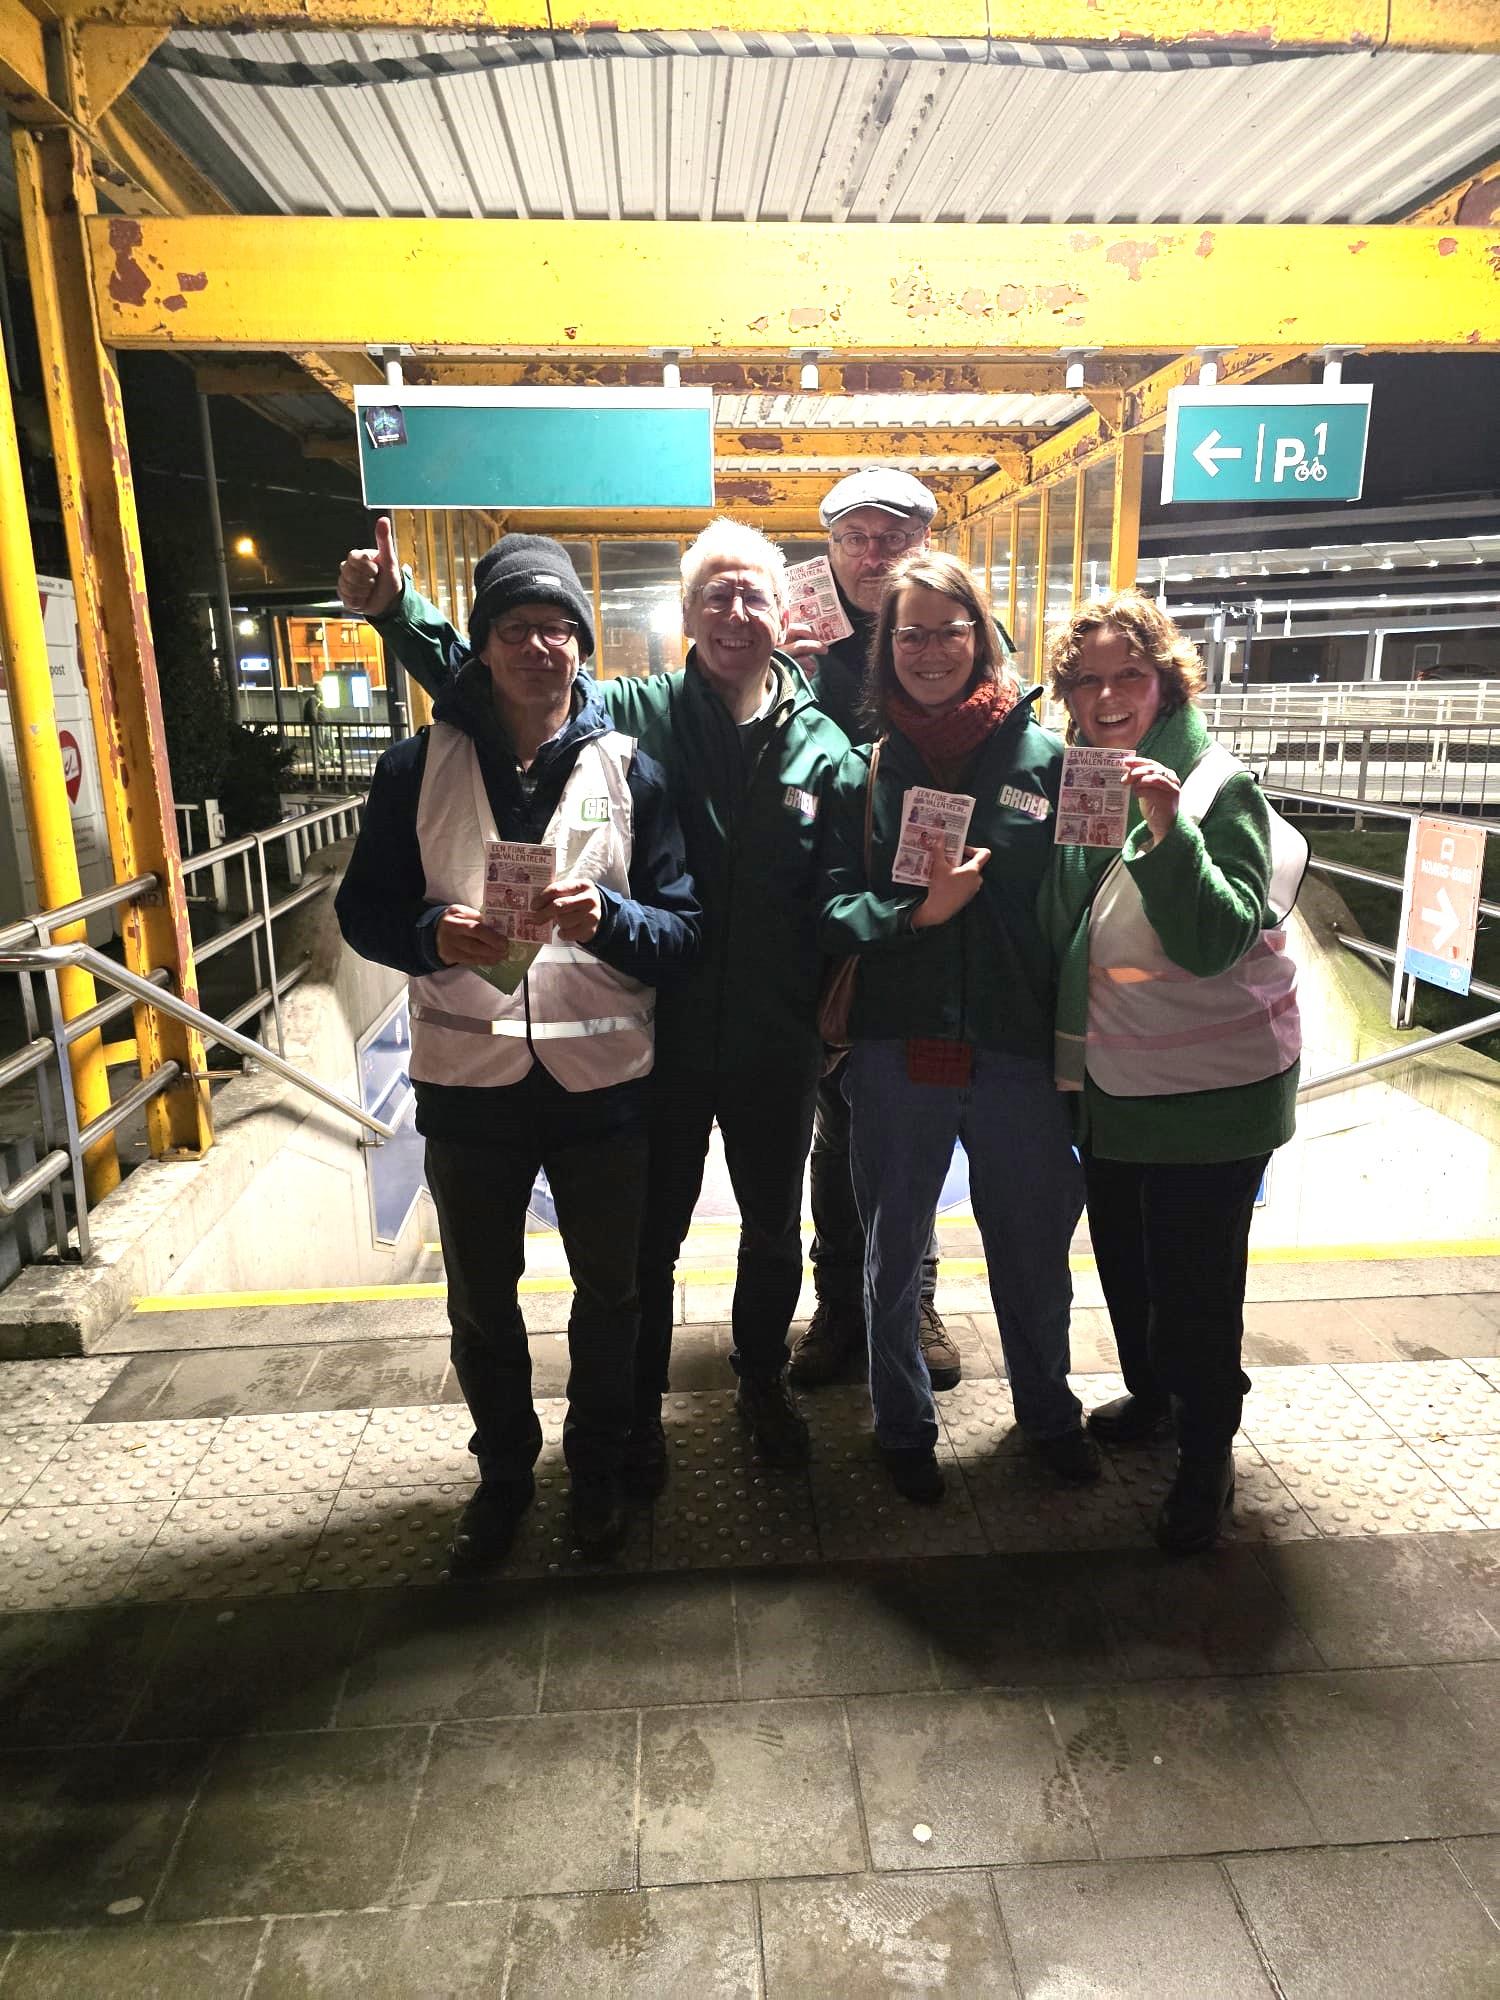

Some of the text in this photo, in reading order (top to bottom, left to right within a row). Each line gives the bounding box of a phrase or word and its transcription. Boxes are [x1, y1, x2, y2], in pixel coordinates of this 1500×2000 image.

[1274, 422, 1328, 483] P 1
[999, 785, 1050, 819] GROEN
